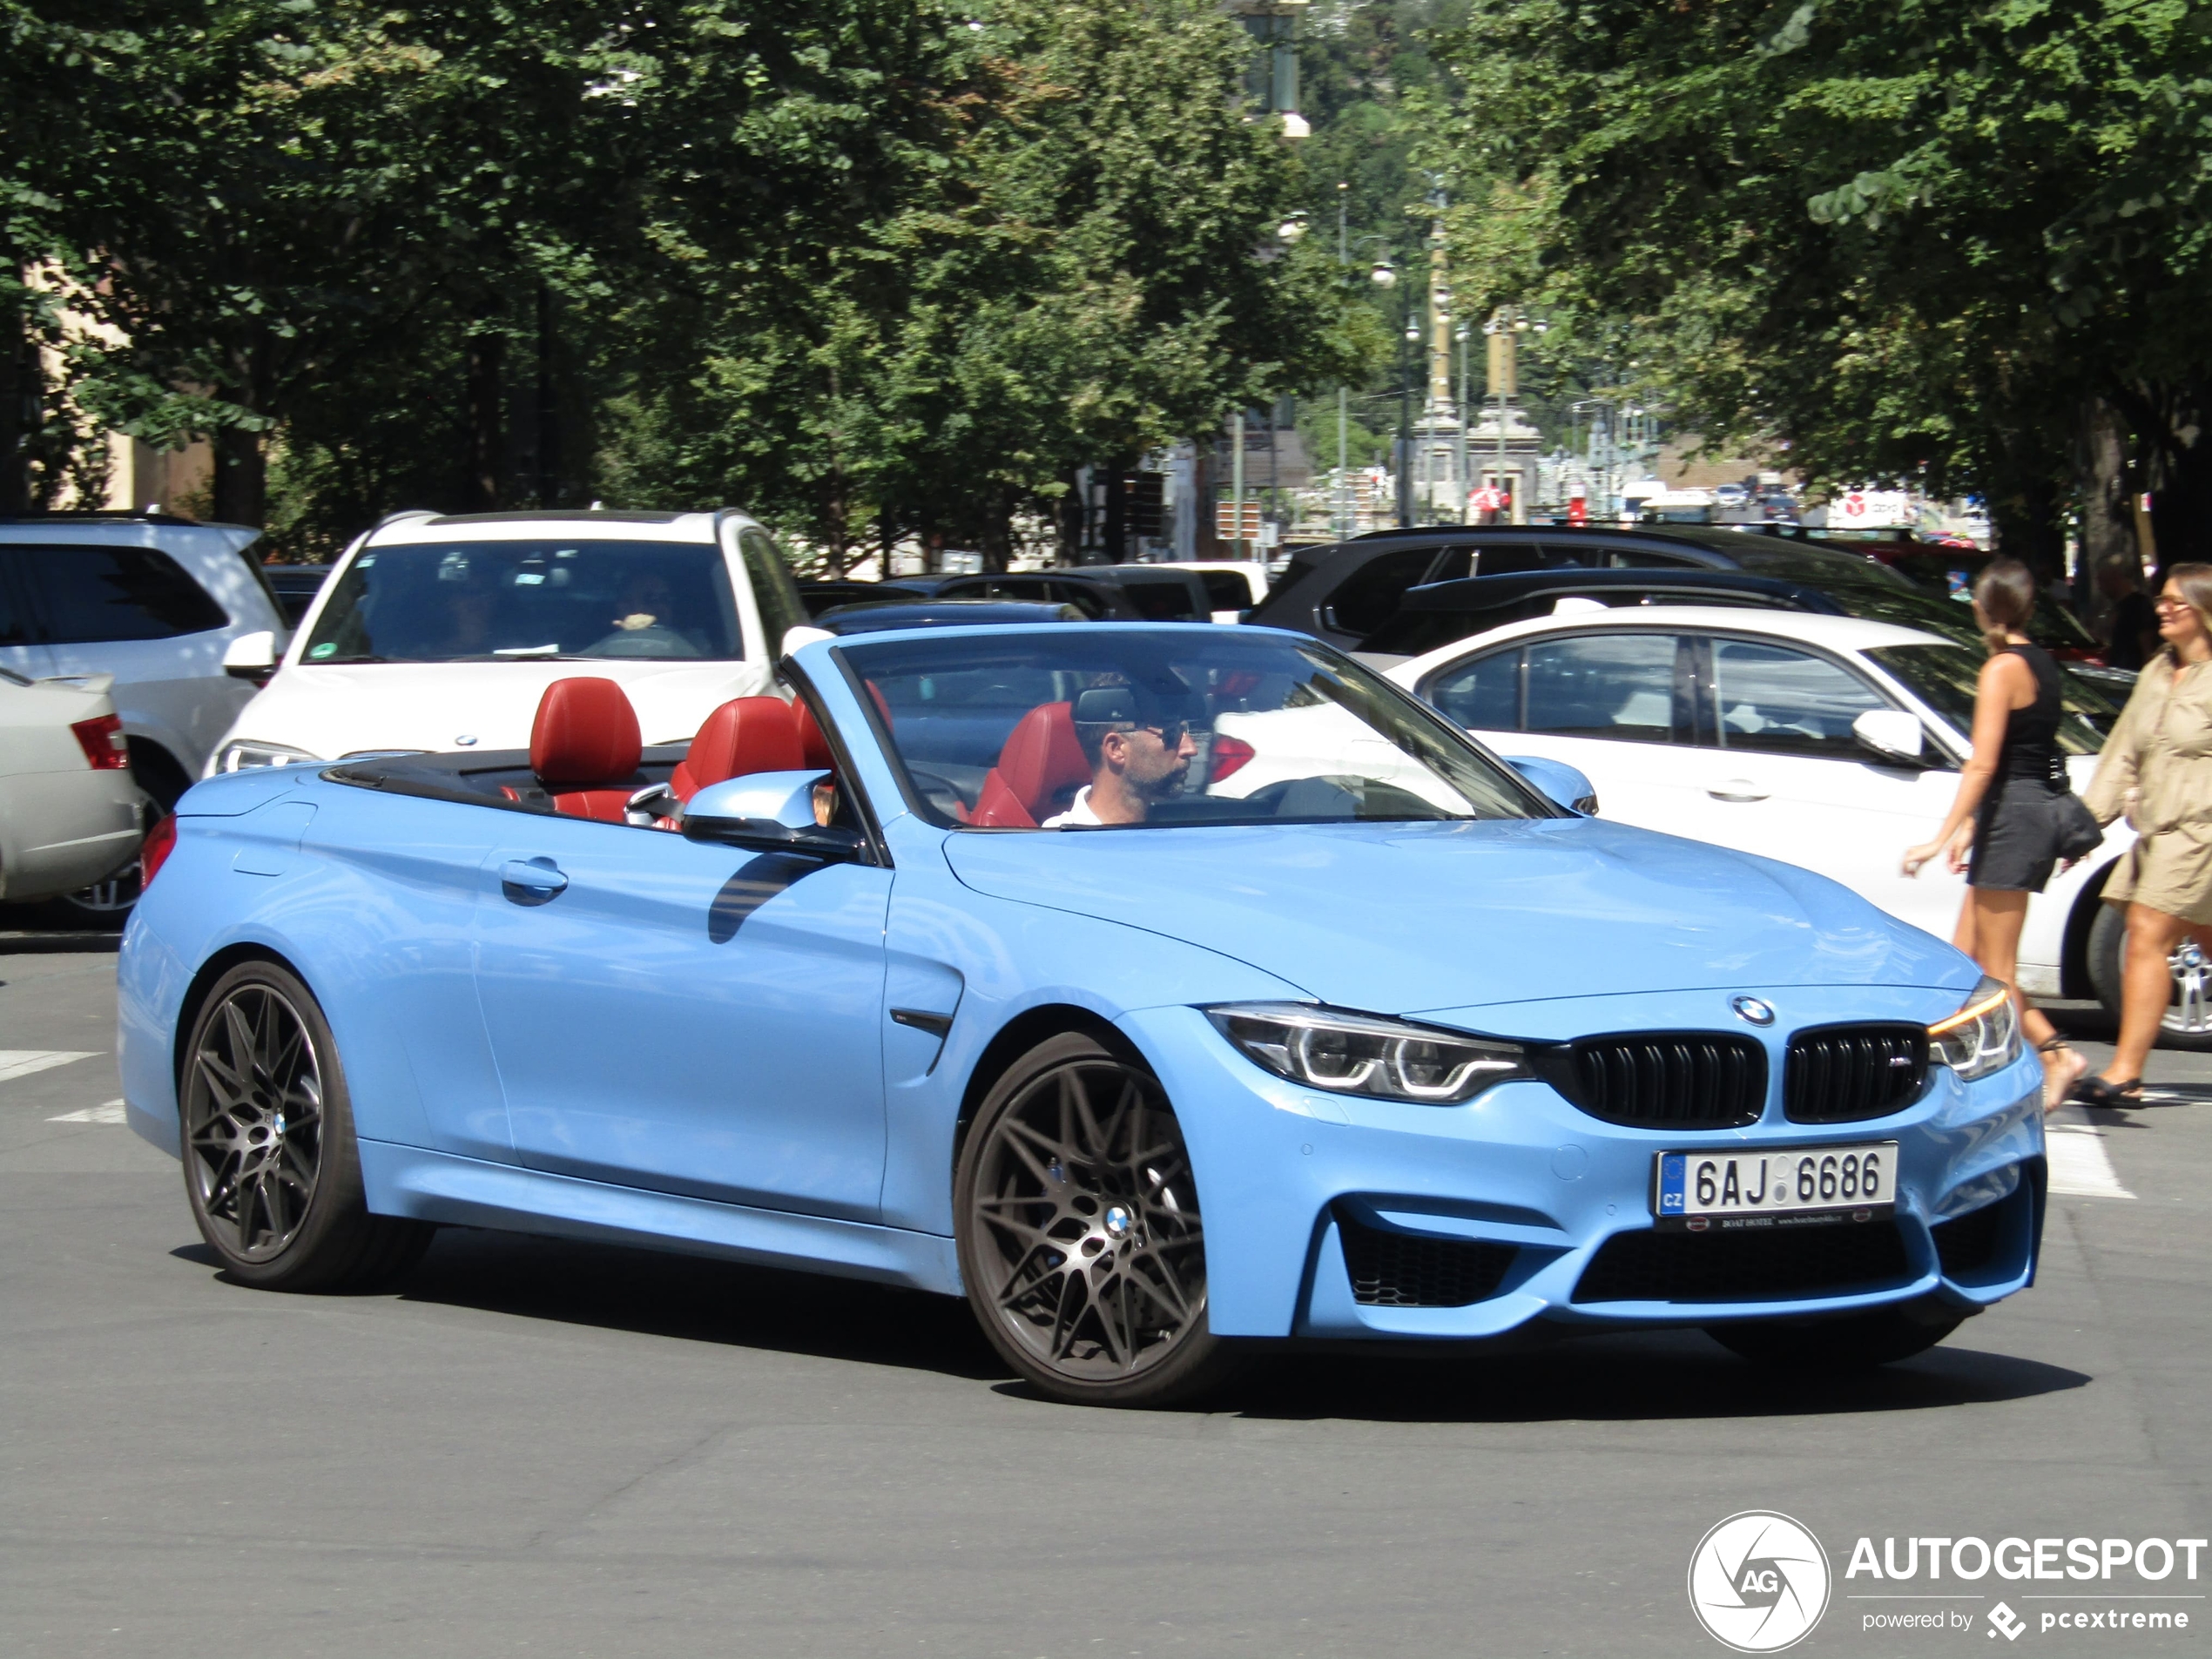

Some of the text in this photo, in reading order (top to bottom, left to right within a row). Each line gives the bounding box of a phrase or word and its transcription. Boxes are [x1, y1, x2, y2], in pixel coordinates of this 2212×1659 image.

[1696, 1151, 1879, 1206] 6AJ 6686
[1663, 1192, 1683, 1207] CZ
